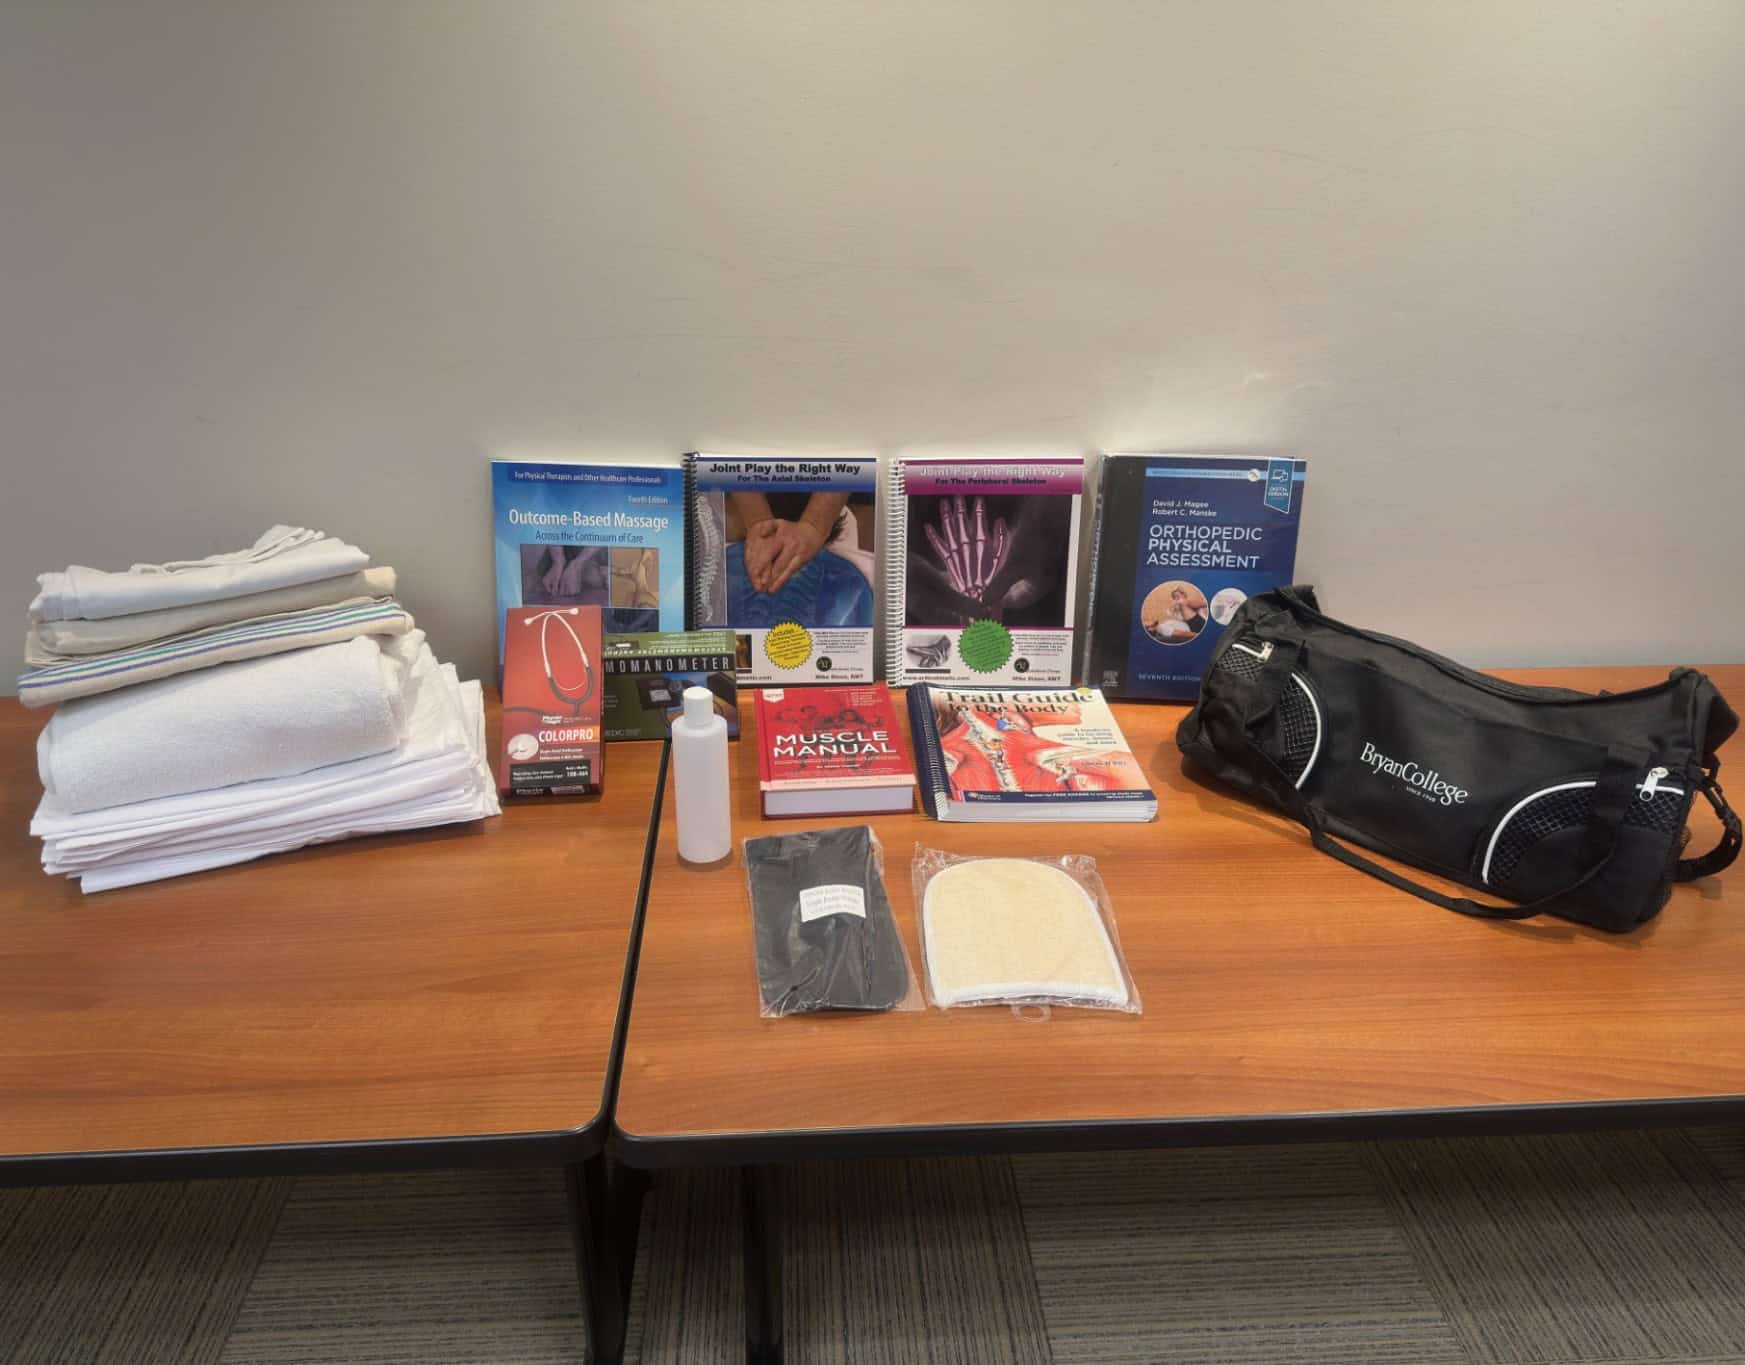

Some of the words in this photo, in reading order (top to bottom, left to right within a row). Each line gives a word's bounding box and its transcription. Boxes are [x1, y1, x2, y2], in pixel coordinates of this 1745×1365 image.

[524, 471, 546, 481] Physical
[583, 472, 599, 481] Other
[709, 463, 741, 473] Joint
[744, 463, 772, 475] Play
[775, 463, 795, 473] the
[799, 463, 832, 475] Right
[835, 463, 861, 475] Way
[920, 466, 949, 477] Joint
[952, 466, 978, 478] Play
[982, 466, 1002, 476] the
[1005, 465, 1038, 478] Right
[1040, 466, 1065, 478] Way
[967, 478, 1009, 486] Peripheral
[1184, 500, 1209, 509] Magee
[1152, 508, 1178, 516] Robert
[1189, 509, 1217, 517] Manske
[508, 508, 611, 528] Outcome-Based
[613, 511, 669, 532] Massage
[535, 530, 560, 541] Across
[561, 530, 574, 541] the
[575, 531, 617, 543] Continuum
[618, 532, 627, 543] of
[627, 533, 645, 545] Care
[1149, 524, 1263, 541] ORTHOPEDIC
[1148, 539, 1232, 553] PHYSICAL
[1146, 553, 1260, 569] ASSESSMENT
[605, 656, 730, 673] MOMANOMETER
[944, 691, 1005, 704] Trail
[1011, 691, 1094, 704] Guide
[950, 703, 969, 713] to
[975, 703, 1009, 713] the
[1015, 703, 1070, 715] Body
[538, 728, 594, 743] COLORPRO
[775, 730, 889, 746] MUSCLE
[773, 742, 897, 758] MANUAL
